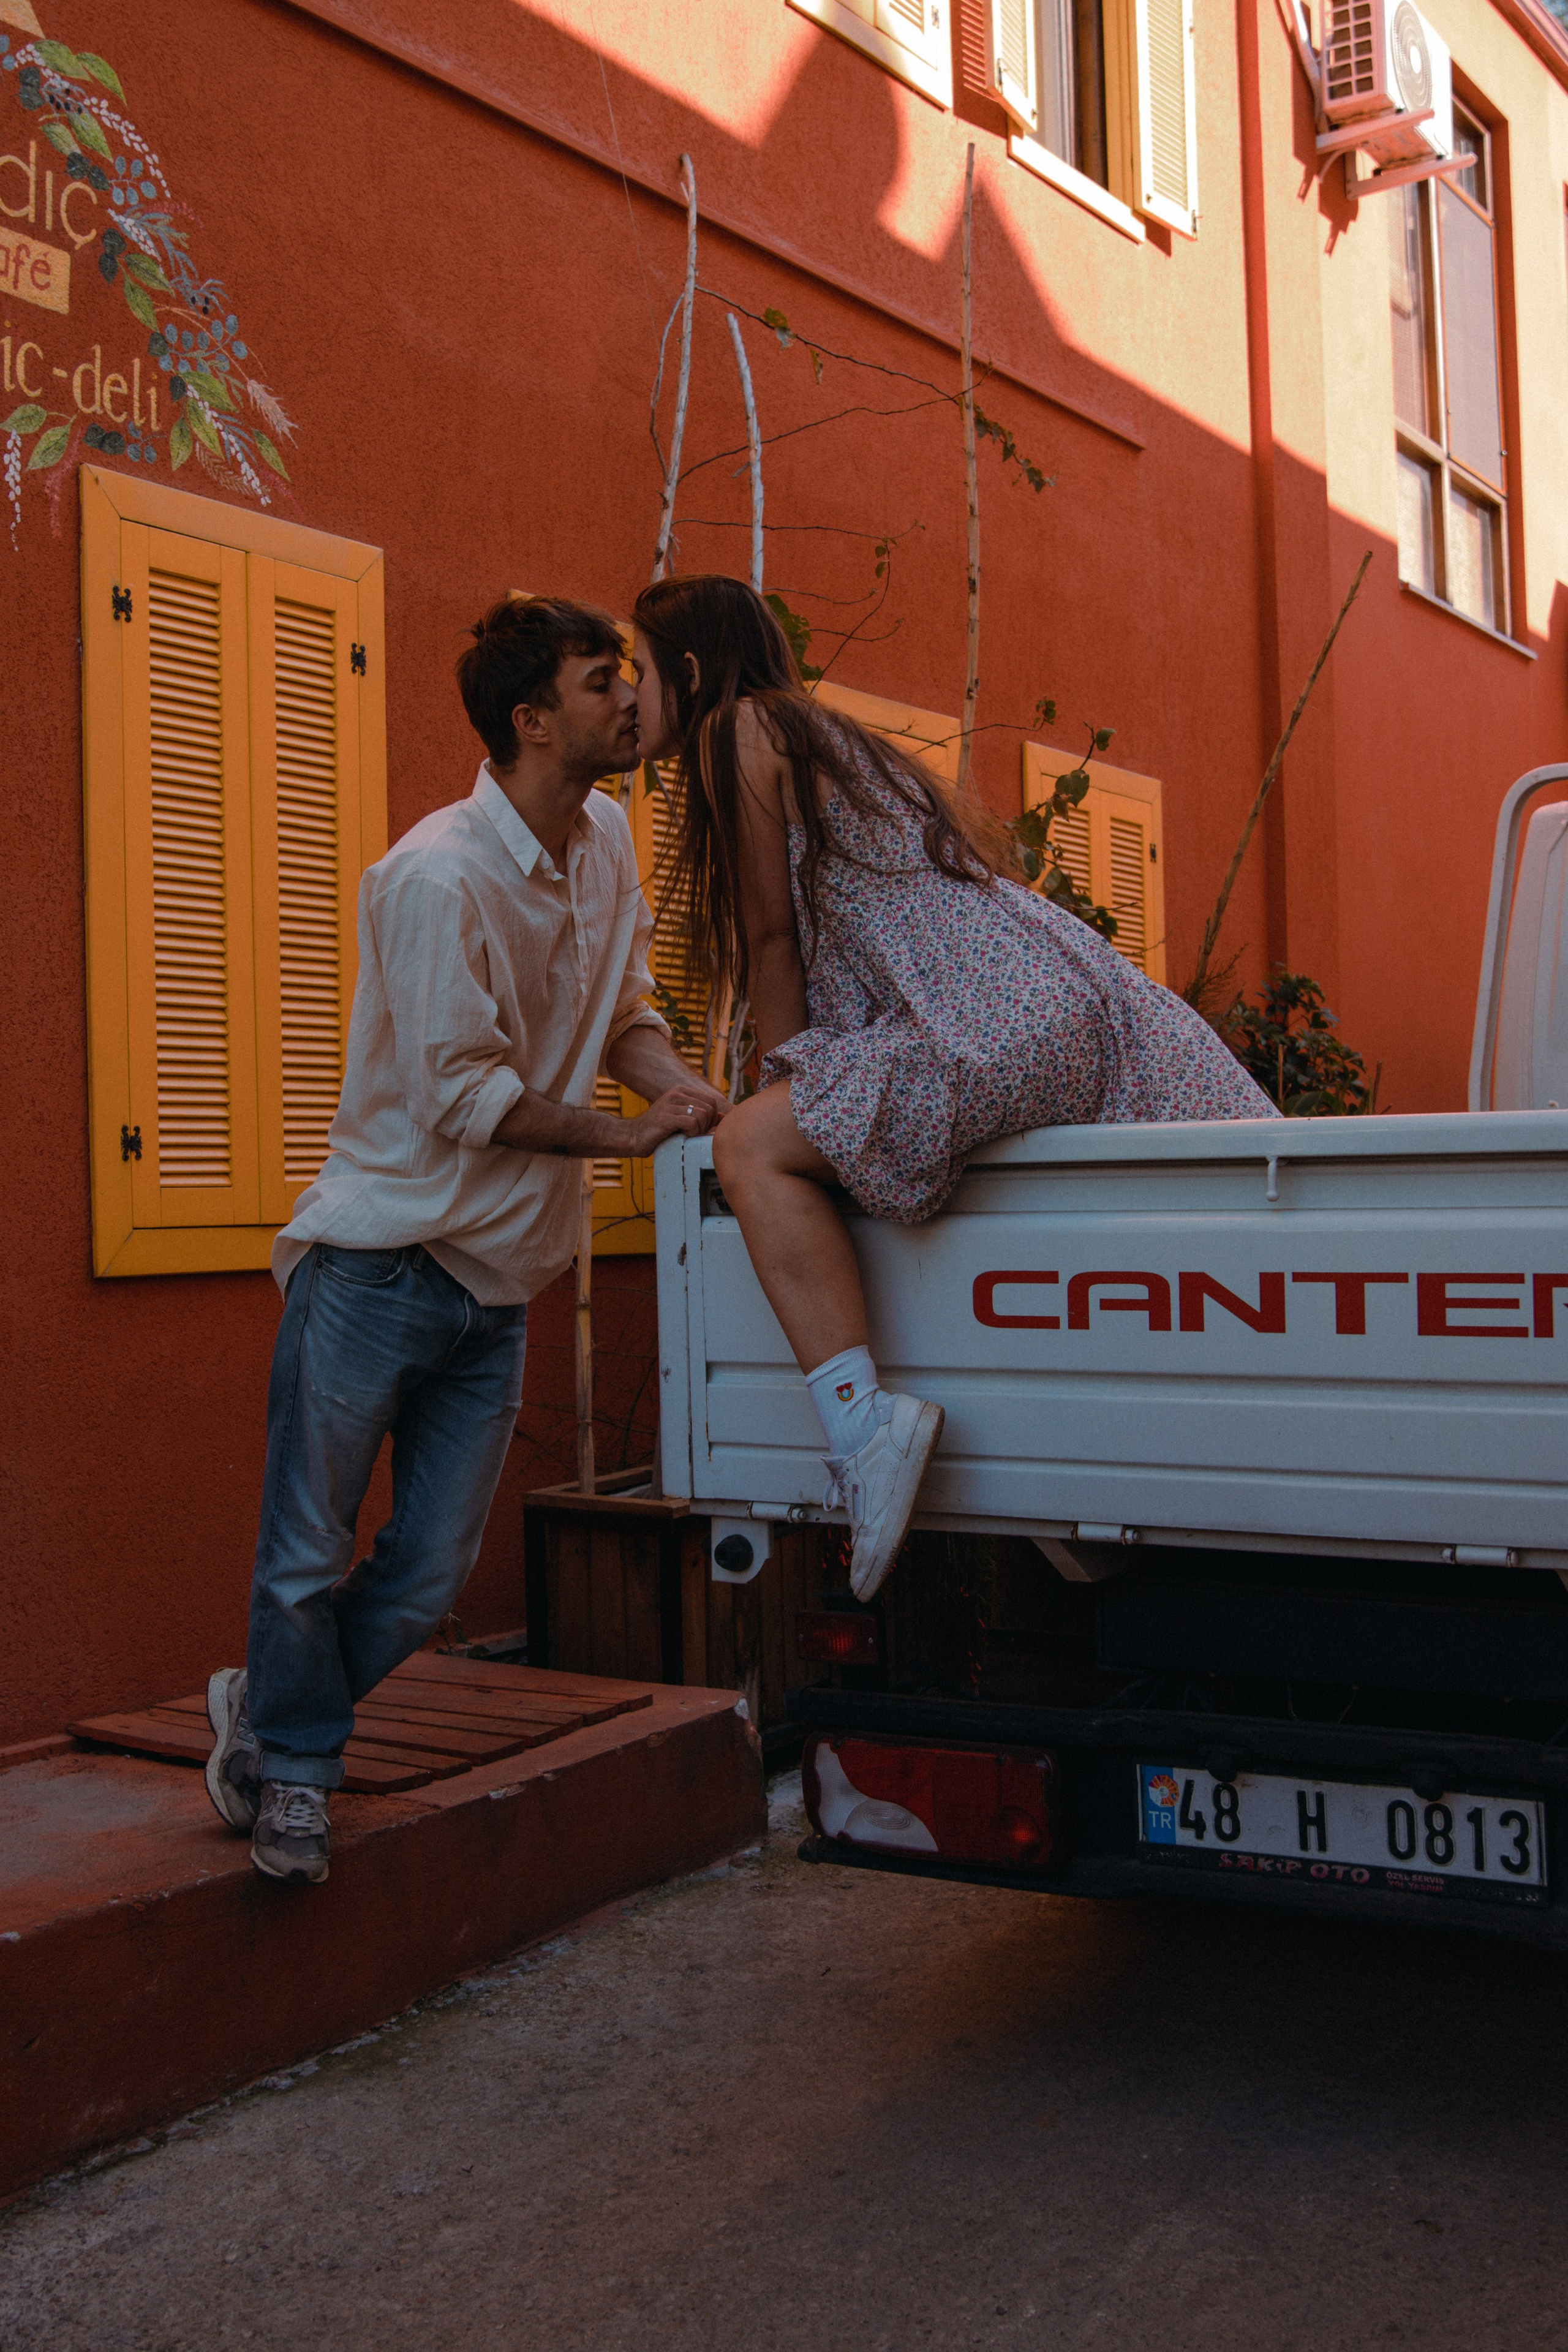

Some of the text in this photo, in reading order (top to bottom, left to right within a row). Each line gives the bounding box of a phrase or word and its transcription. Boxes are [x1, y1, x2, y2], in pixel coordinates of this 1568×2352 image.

[1148, 1811, 1172, 1829] TR
[1178, 1779, 1531, 1875] 48 H 0813
[1310, 1863, 1370, 1884] OTO
